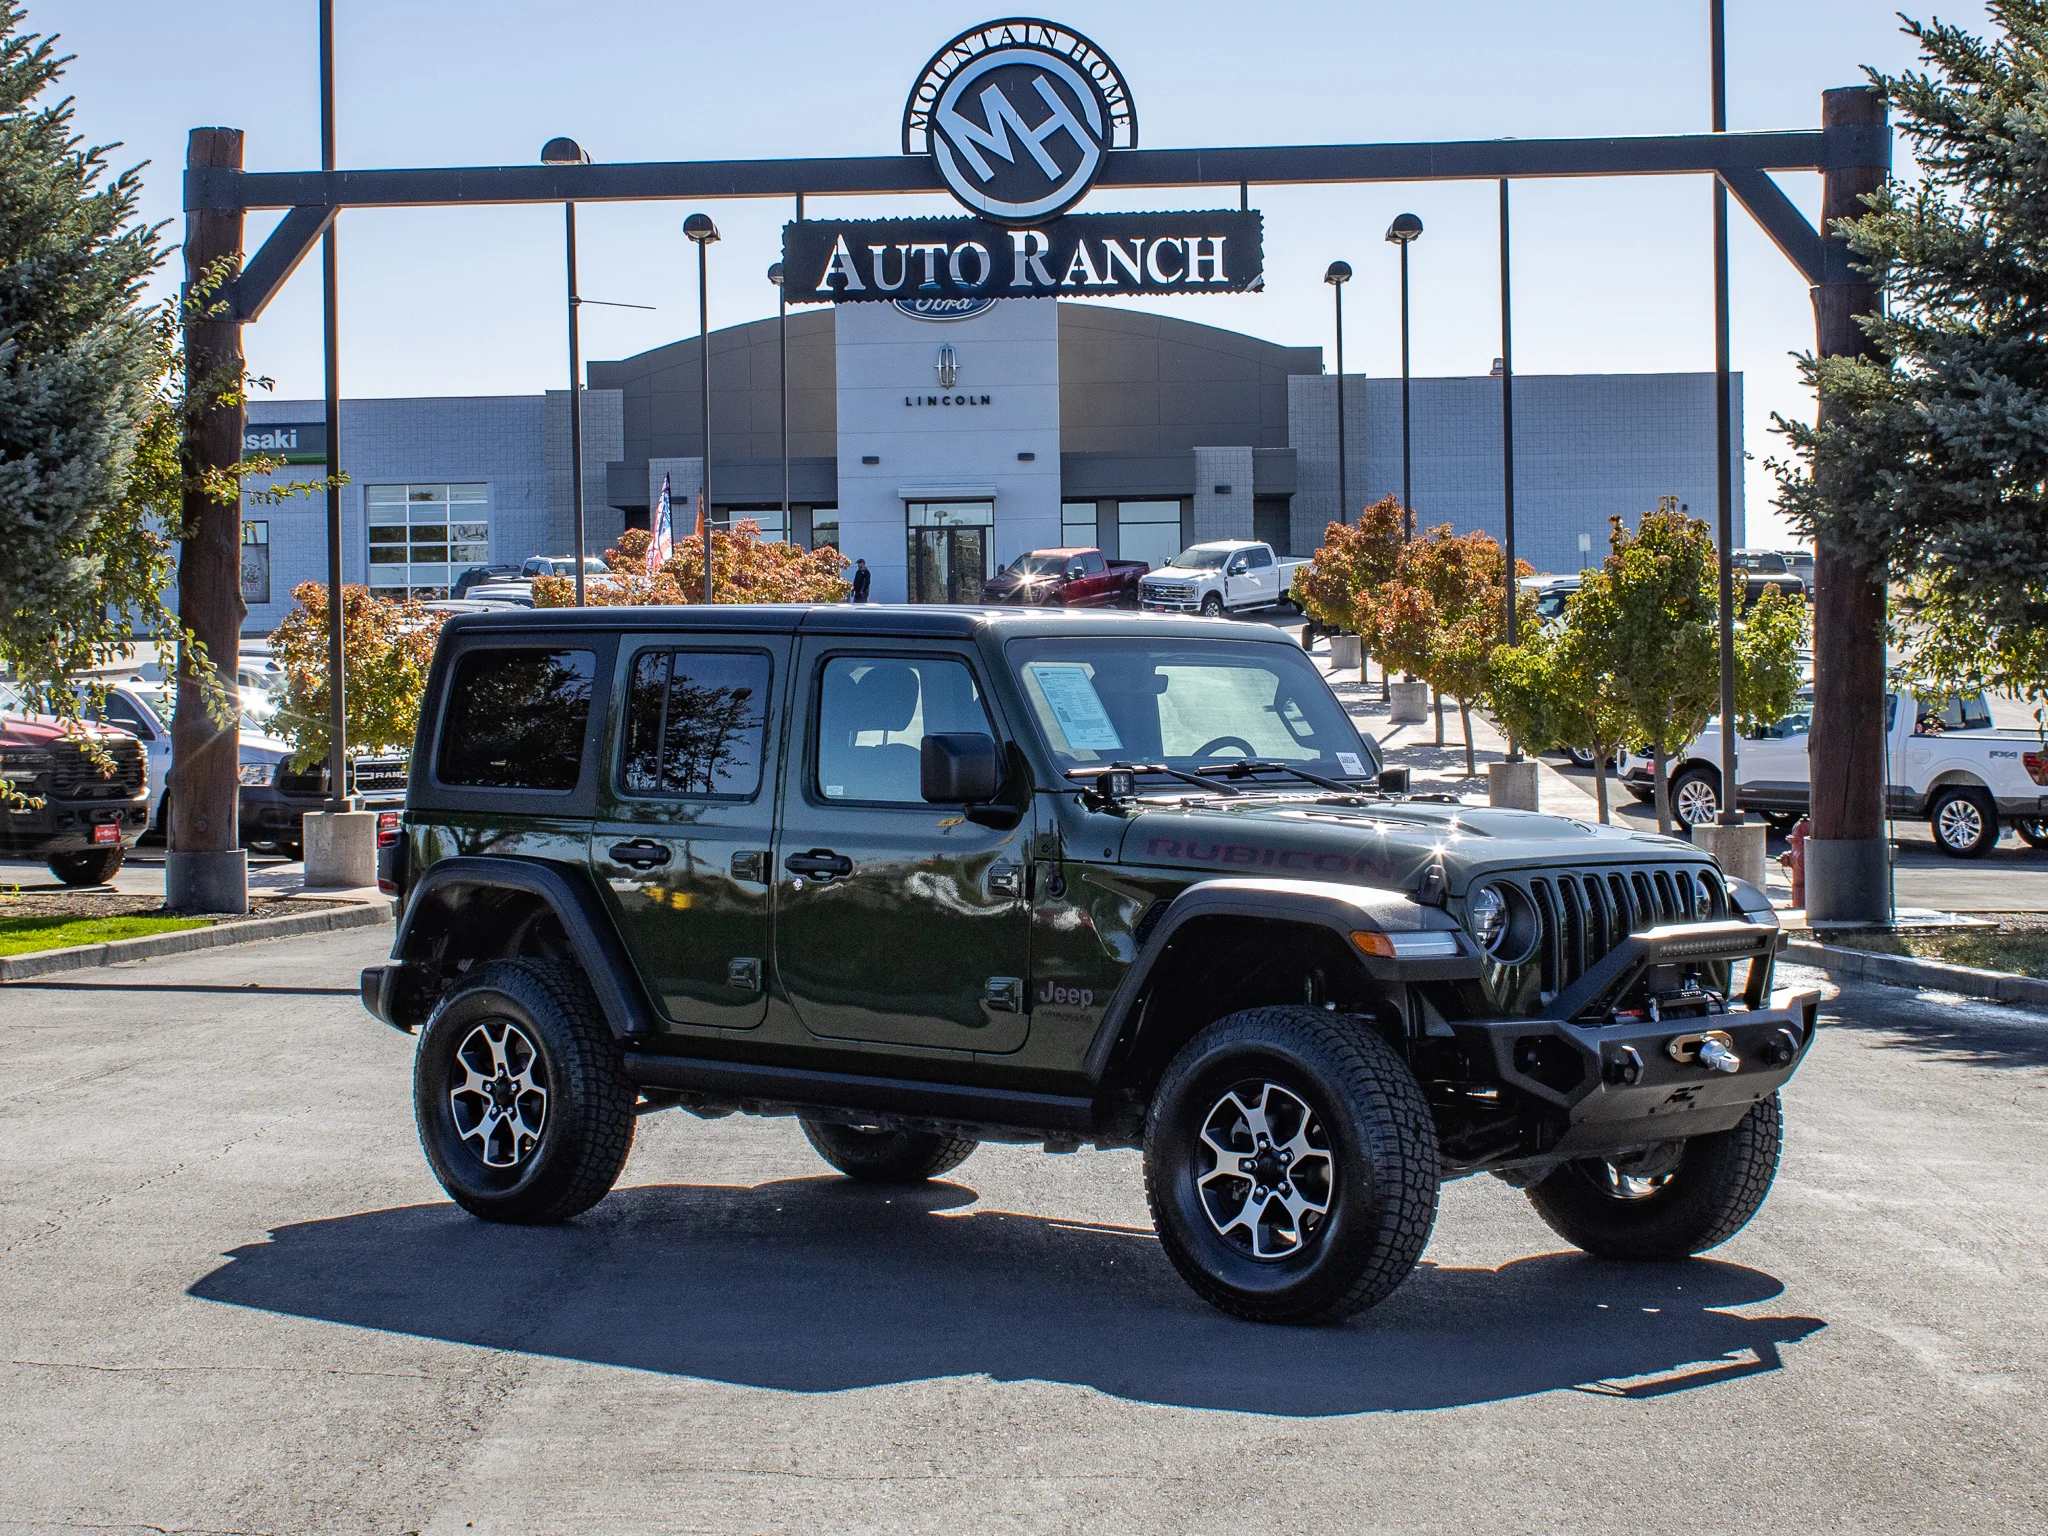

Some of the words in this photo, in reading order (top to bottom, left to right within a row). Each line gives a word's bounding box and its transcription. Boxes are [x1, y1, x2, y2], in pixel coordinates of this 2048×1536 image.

[909, 23, 1058, 133] MOUNTAIN
[1068, 41, 1131, 129] HOME
[936, 74, 1100, 183] MH
[815, 233, 991, 291] AUTO
[1007, 230, 1229, 286] RANCH
[905, 395, 991, 406] LINCOLN
[1989, 750, 2019, 759] FX4
[375, 771, 402, 779] RAM
[1144, 837, 1397, 878] RUBICON
[1040, 981, 1094, 1010] Jeep
